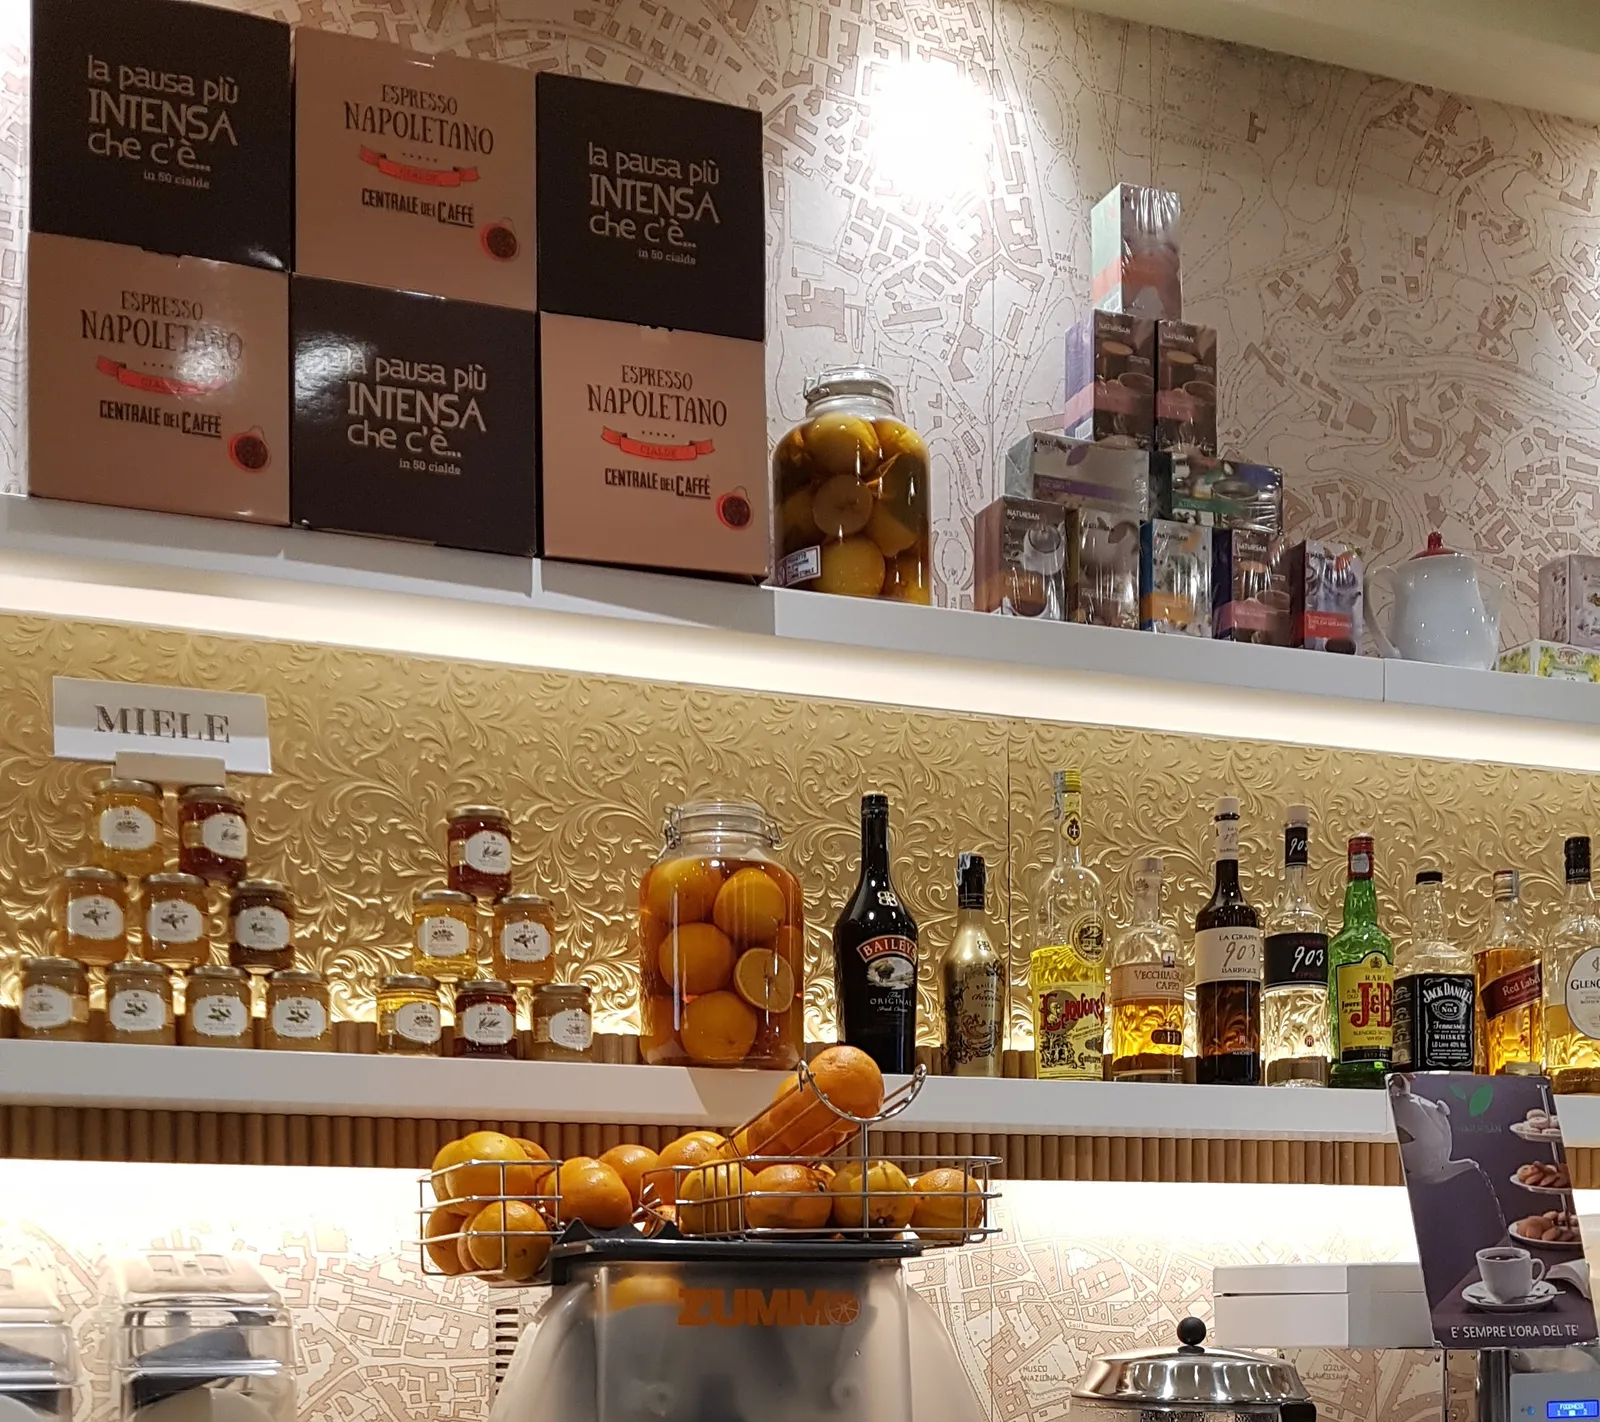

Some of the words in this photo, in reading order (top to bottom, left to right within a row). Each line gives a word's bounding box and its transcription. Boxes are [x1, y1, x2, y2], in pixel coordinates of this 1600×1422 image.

[87, 55, 110, 81] la
[119, 65, 195, 97] pausa
[203, 77, 239, 104] più
[381, 83, 459, 116] ESPRESSO
[87, 87, 239, 147] INTENSA
[343, 100, 495, 156] NAPOLETANO
[87, 132, 141, 160] che
[588, 141, 608, 168] la
[616, 151, 682, 182] pausa
[688, 160, 720, 186] più
[143, 170, 157, 182] in
[158, 172, 173, 184] 50
[174, 174, 211, 190] cialde
[360, 187, 419, 215] CENTRALE
[589, 171, 721, 225] INTENSA
[588, 212, 637, 241] che
[637, 248, 649, 260] in
[650, 250, 664, 262] 50
[665, 252, 697, 265] cialde
[120, 289, 204, 321] ESPRESSO
[375, 356, 446, 386] pausa
[453, 363, 487, 392] più
[620, 364, 694, 392] ESPRESSO
[99, 399, 161, 426] CENTRALE
[347, 380, 487, 433] INTENSA
[587, 383, 728, 428] NAPOLETANO
[347, 421, 396, 449] che
[399, 457, 410, 470] in
[412, 460, 427, 473] 50
[428, 462, 462, 477] cialde
[604, 467, 659, 490] CENTRALE
[1006, 508, 1041, 520] NATURSAN
[93, 703, 232, 744] MIELE
[862, 938, 917, 959] BAILEYS
[1223, 941, 1256, 967] 903
[1291, 945, 1324, 973] 903
[1422, 985, 1444, 1004] JACK
[1501, 982, 1520, 997] Red
[1520, 973, 1541, 990] Label
[869, 997, 913, 1007] ORIGINAL
[1350, 982, 1393, 1028] J&B
[677, 1288, 861, 1327] ZUMMO
[1451, 1326, 1460, 1339] E'
[1462, 1325, 1507, 1339] SEMPRE
[1508, 1325, 1541, 1338] L'ORA
[1542, 1324, 1563, 1337] DEL
[1564, 1324, 1579, 1337] TE'
